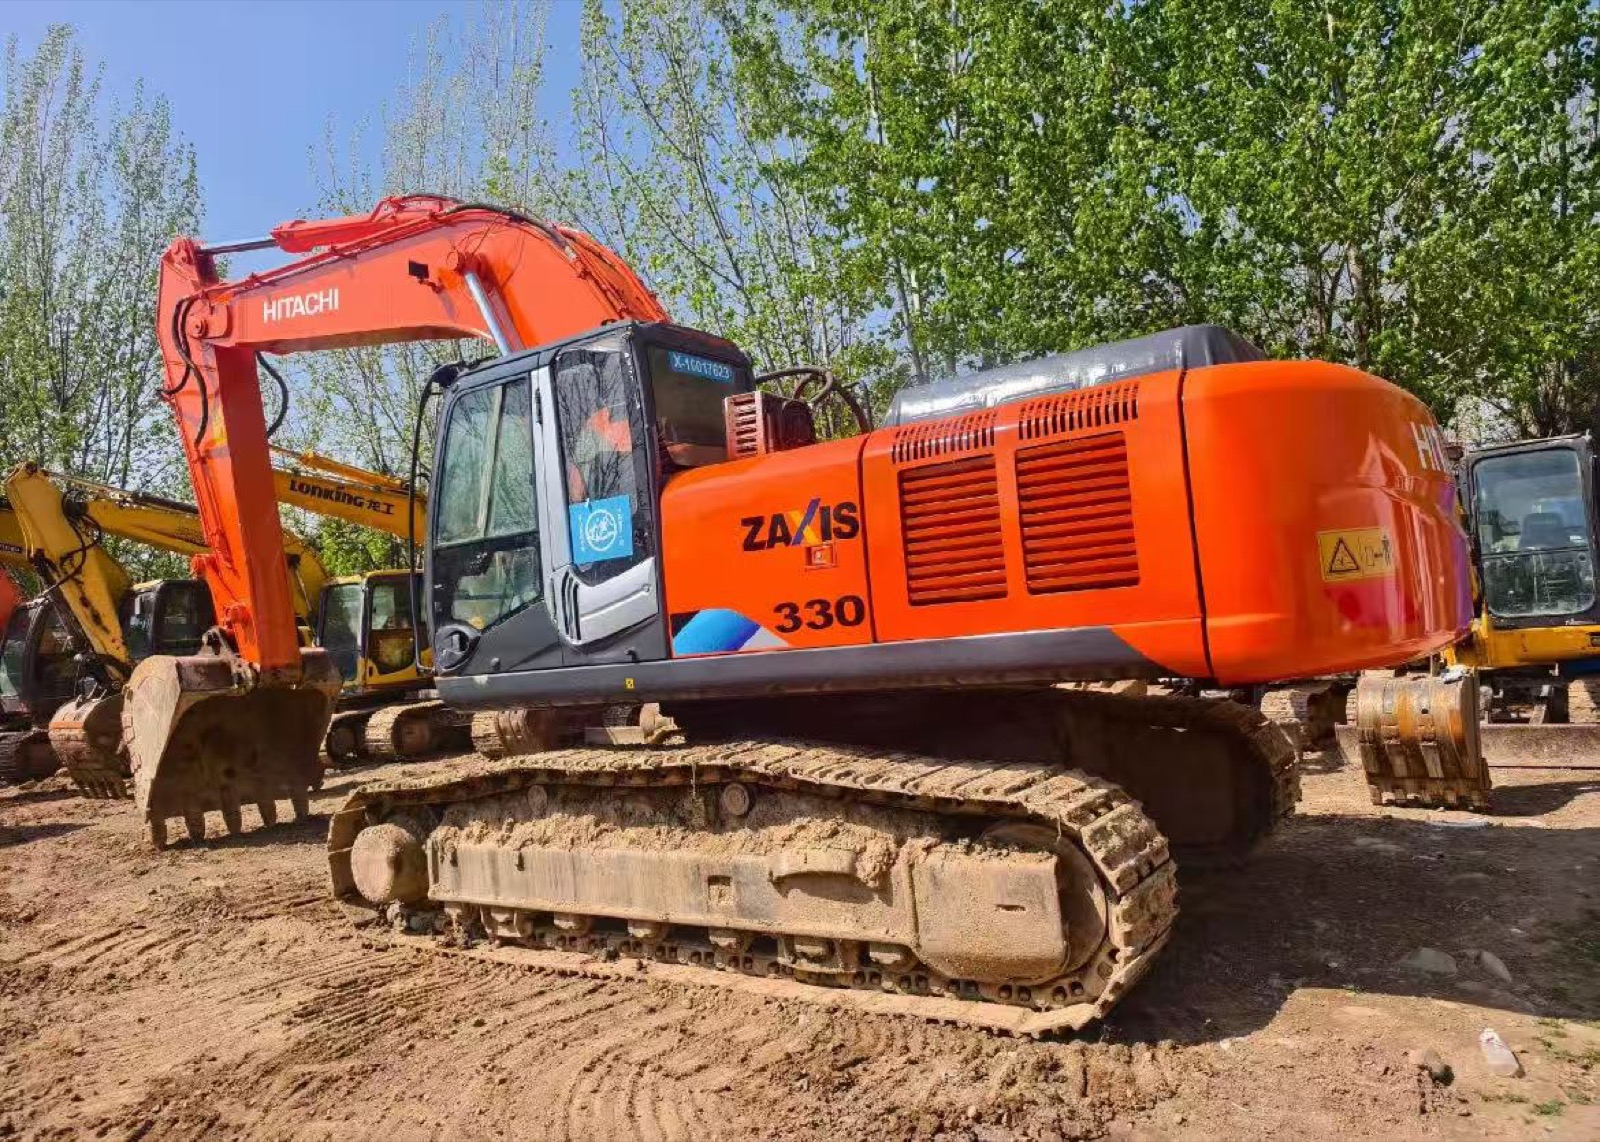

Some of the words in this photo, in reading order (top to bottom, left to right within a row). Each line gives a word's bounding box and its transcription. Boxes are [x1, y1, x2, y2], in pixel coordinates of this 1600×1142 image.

[263, 288, 339, 324] HITACHI
[740, 498, 860, 552] ZAXIS
[773, 595, 865, 633] 330
